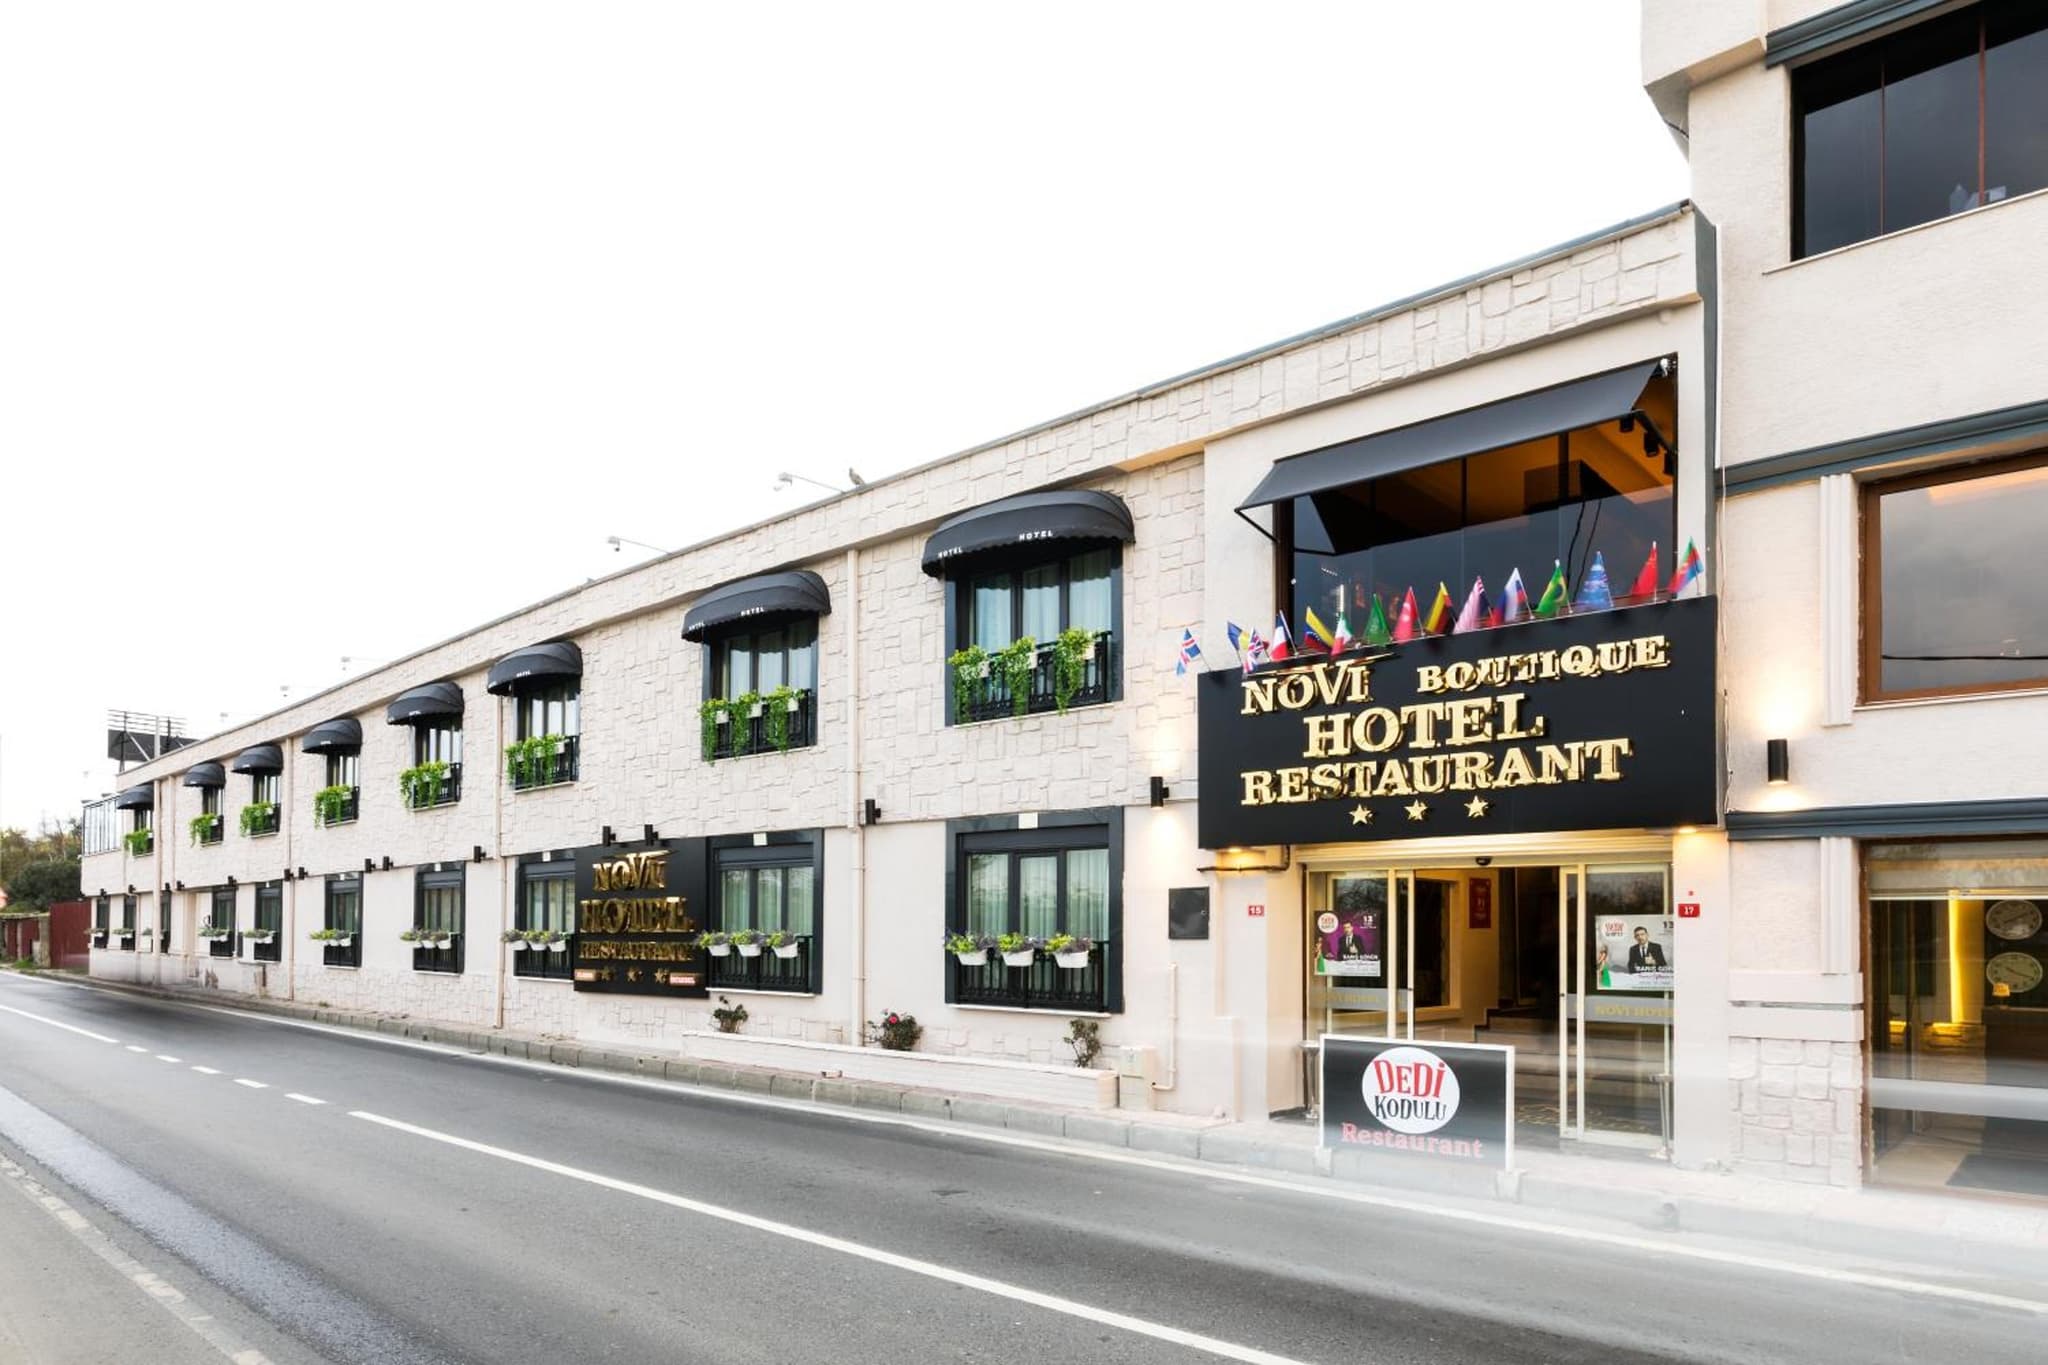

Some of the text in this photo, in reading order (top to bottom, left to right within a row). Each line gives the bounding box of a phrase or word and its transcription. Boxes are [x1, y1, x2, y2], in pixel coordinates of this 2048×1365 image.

[938, 547, 962, 558] HOTEL
[1019, 530, 1053, 540] HOTEL
[1417, 635, 1671, 694] BOUTIQUE
[1303, 692, 1545, 758] HOTEL
[1241, 738, 1633, 806] RESTAURANT
[579, 896, 695, 934] HOTEL
[578, 940, 694, 962] RESTAURANT
[1374, 1095, 1447, 1121] KODULU
[1341, 1121, 1484, 1159] Restaurant
